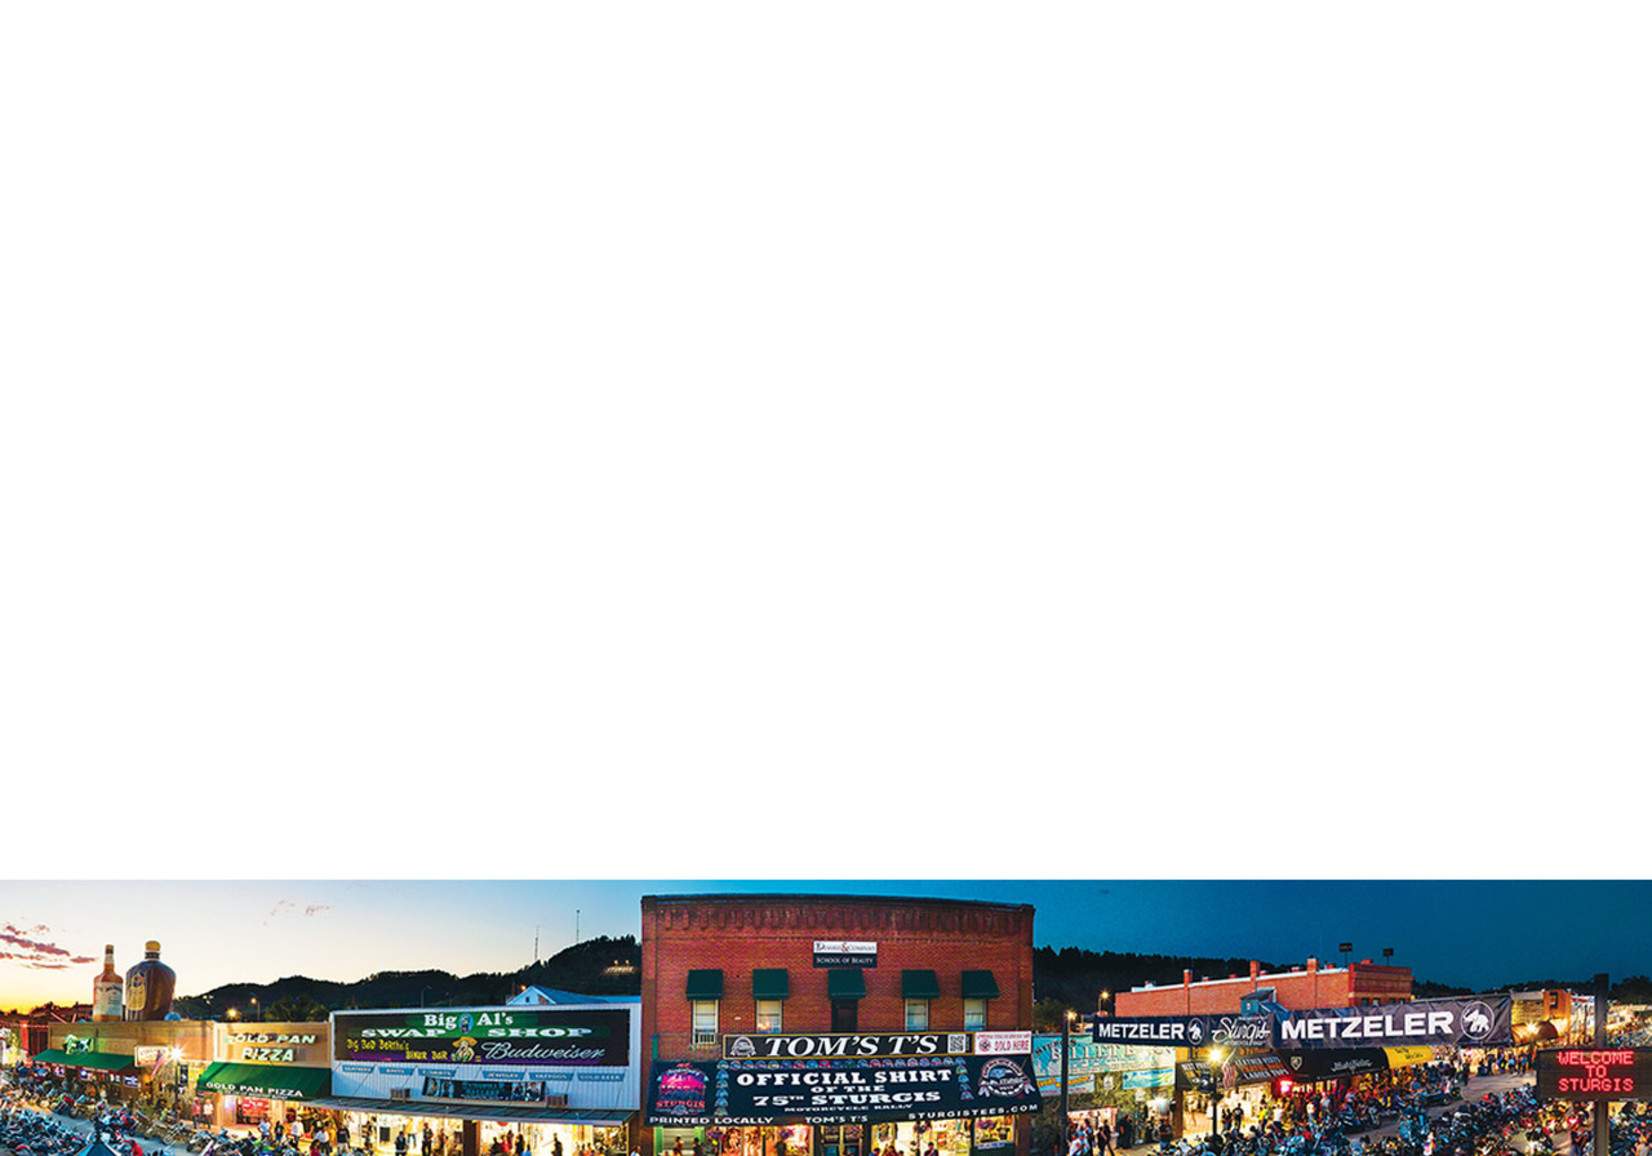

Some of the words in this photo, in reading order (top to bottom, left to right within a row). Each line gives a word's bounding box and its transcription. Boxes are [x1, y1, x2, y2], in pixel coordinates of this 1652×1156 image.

[424, 1013, 457, 1031] Big
[476, 1012, 513, 1026] Al's
[1281, 1010, 1455, 1040] METZELER
[361, 1028, 446, 1038] SWAP
[488, 1027, 592, 1037] SHOP
[1098, 1022, 1185, 1040] METZELER
[276, 1034, 316, 1044] PAN
[765, 1035, 879, 1057] TOM'S
[888, 1034, 939, 1055] T'S
[1013, 1039, 1029, 1051] HERE
[241, 1047, 294, 1063] PIZZA
[481, 1042, 605, 1060] Budweiser
[1558, 1051, 1634, 1065] WELCOME
[736, 1072, 867, 1086] OFFICIAL
[874, 1069, 952, 1084] SHIRT
[1585, 1065, 1607, 1078] TO
[206, 1082, 236, 1091] GOLD
[240, 1085, 263, 1094] PAN
[268, 1088, 303, 1097] PIZZA
[1558, 1078, 1634, 1092] STURGIS
[811, 1091, 941, 1105] STURGIS
[650, 1116, 710, 1124] PRINTED
[714, 1116, 774, 1125] LOCALLY
[804, 1116, 846, 1124] TOM'S
[850, 1115, 868, 1123] T'S
[908, 1103, 1038, 1120] STURGISTEES.COM
